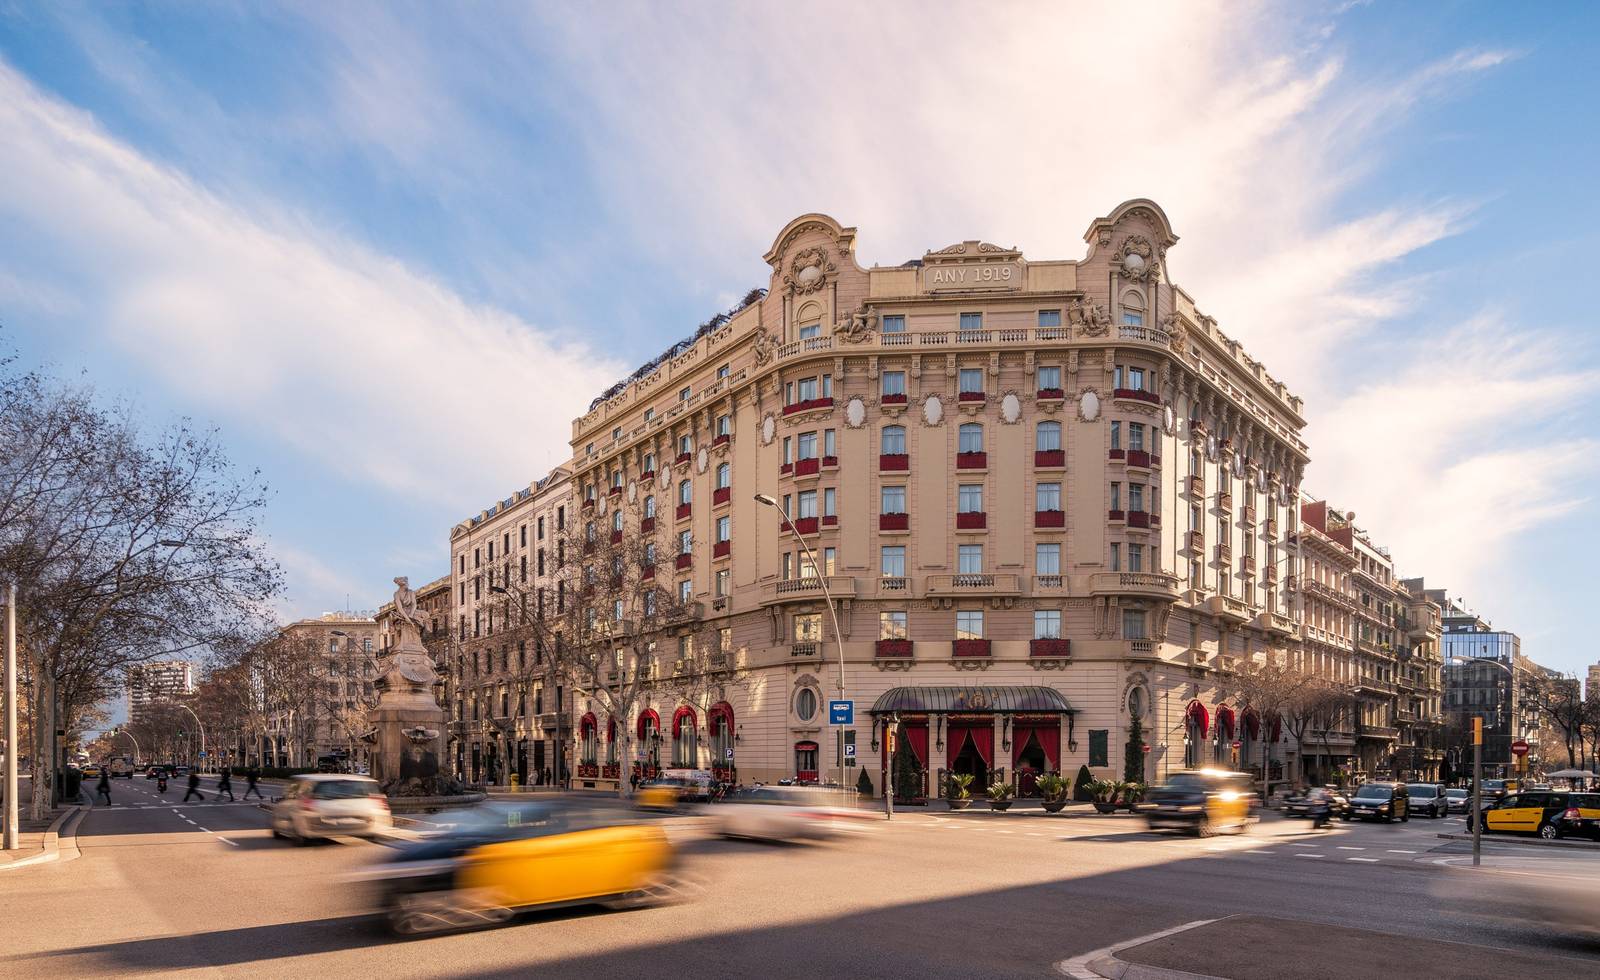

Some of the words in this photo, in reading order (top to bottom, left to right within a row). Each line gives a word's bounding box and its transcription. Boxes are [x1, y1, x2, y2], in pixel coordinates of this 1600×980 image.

[933, 268, 967, 283] ANY
[975, 267, 1012, 282] 1919
[846, 745, 854, 755] P
